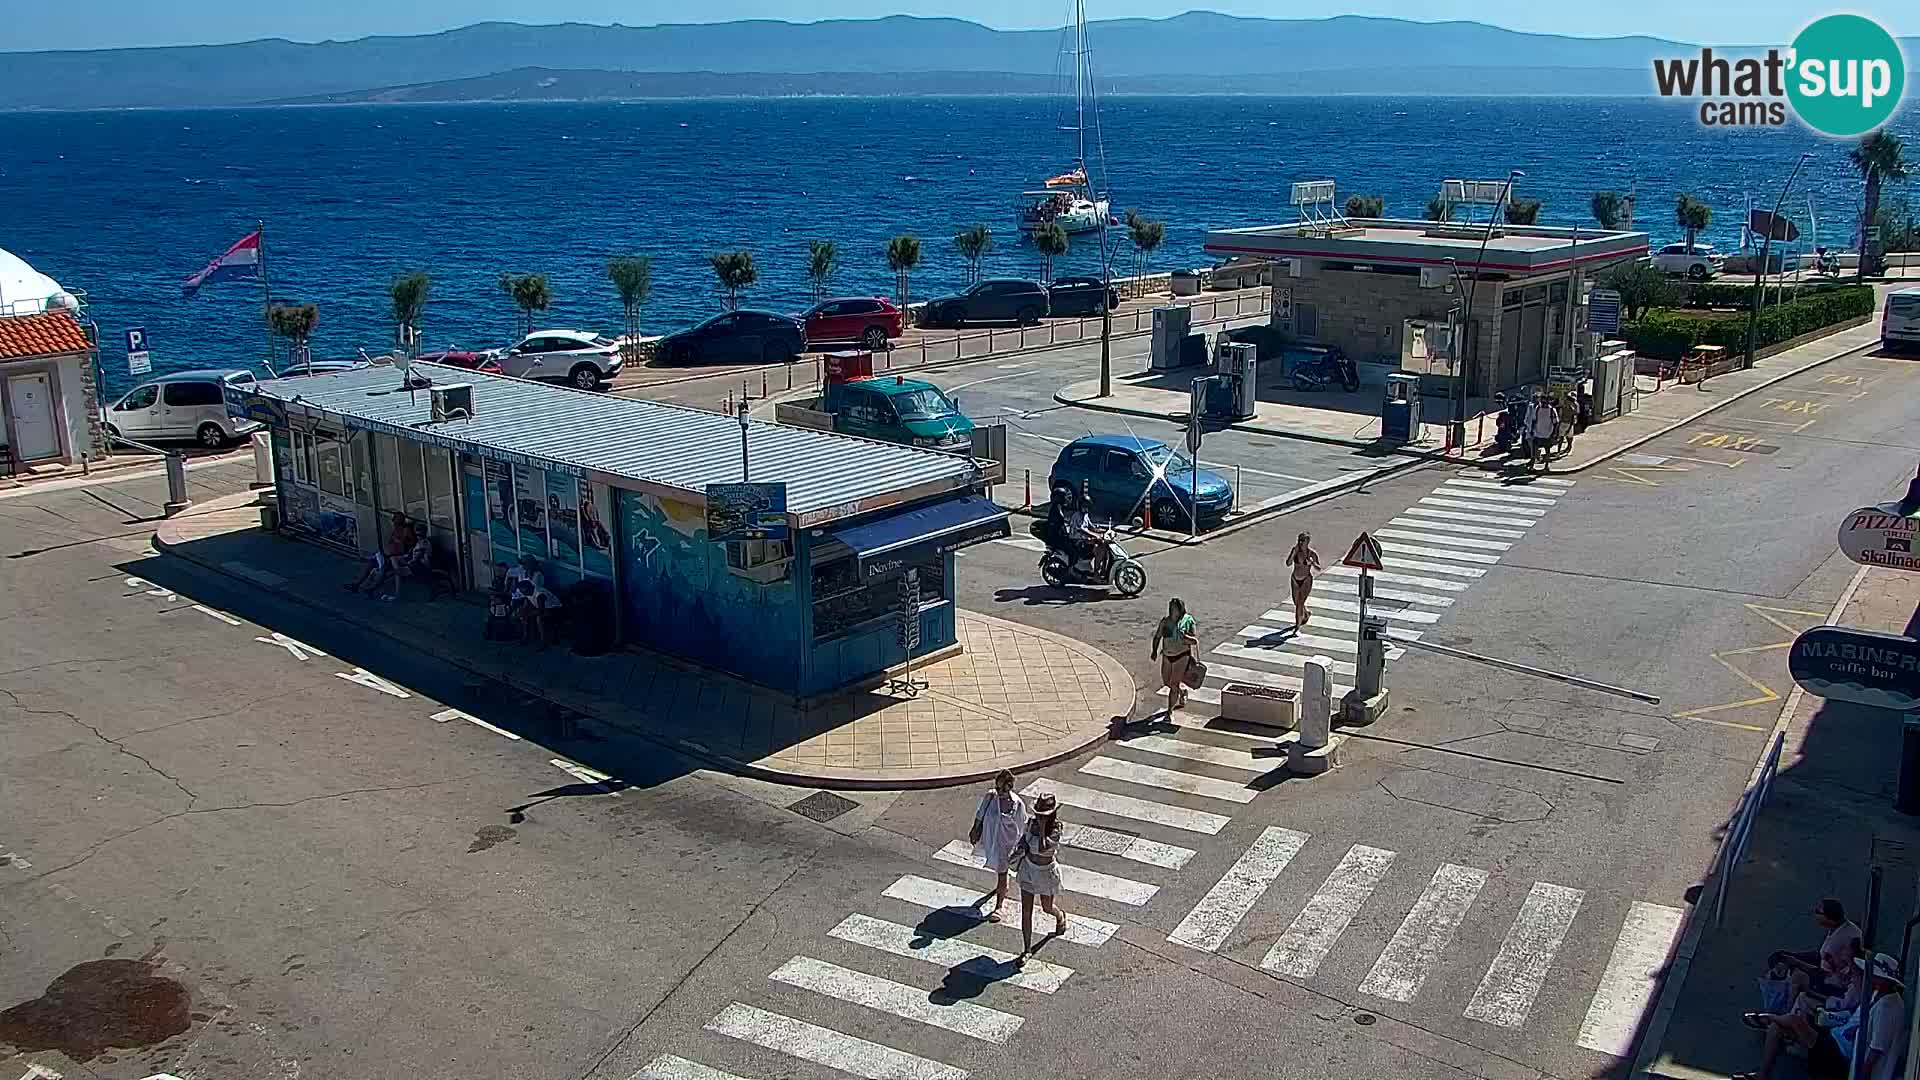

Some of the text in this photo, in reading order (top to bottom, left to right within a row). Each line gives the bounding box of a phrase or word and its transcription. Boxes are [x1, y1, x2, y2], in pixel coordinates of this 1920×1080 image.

[130, 331, 142, 349] P
[1760, 399, 1831, 415] TAXI
[1687, 431, 1766, 451] TAXI
[479, 446, 493, 458] BUS
[494, 449, 526, 465] STATION
[529, 457, 554, 471] TICKET
[556, 463, 582, 477] OFFICE
[1849, 514, 1920, 532] PIZZE
[1802, 642, 1920, 672] MARINER
[1829, 662, 1897, 679] caffe bar
